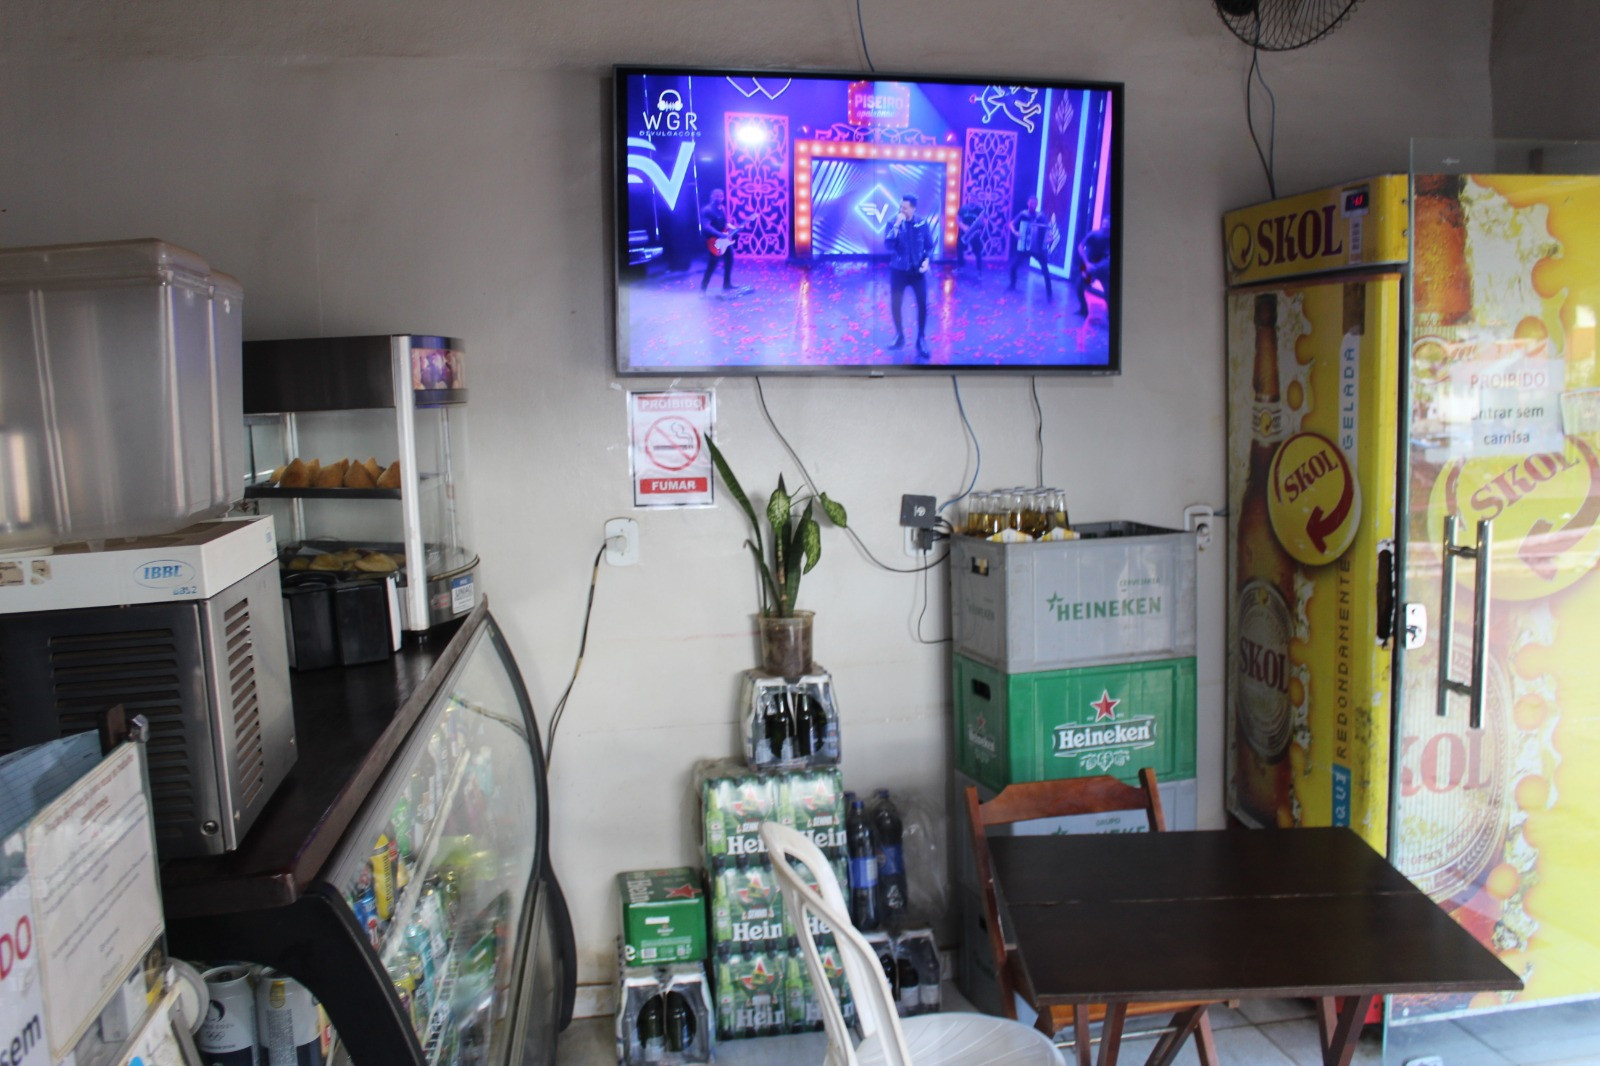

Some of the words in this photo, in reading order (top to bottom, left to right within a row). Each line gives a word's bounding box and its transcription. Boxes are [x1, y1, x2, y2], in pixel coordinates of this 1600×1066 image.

[855, 94, 904, 110] PISEIRO
[643, 111, 697, 130] WGR
[1257, 205, 1343, 267] SKOL
[1471, 372, 1546, 389] PROIBIDO
[641, 398, 702, 409] PROIBIDO
[1342, 347, 1355, 450] GELADA
[1472, 406, 1513, 420] ntrar
[1516, 405, 1544, 418] sem
[1483, 433, 1531, 446] camisa
[652, 481, 697, 491] FUMAR
[1283, 450, 1338, 504] SKOL
[1470, 451, 1580, 522] SKOL
[1057, 597, 1161, 621] HEINEKEN
[1240, 636, 1288, 694] SKOL
[1336, 556, 1351, 759] REDONDAMENTE
[1059, 725, 1150, 750] Heineken
[1335, 772, 1347, 827] QUI
[733, 918, 782, 943] Hein
